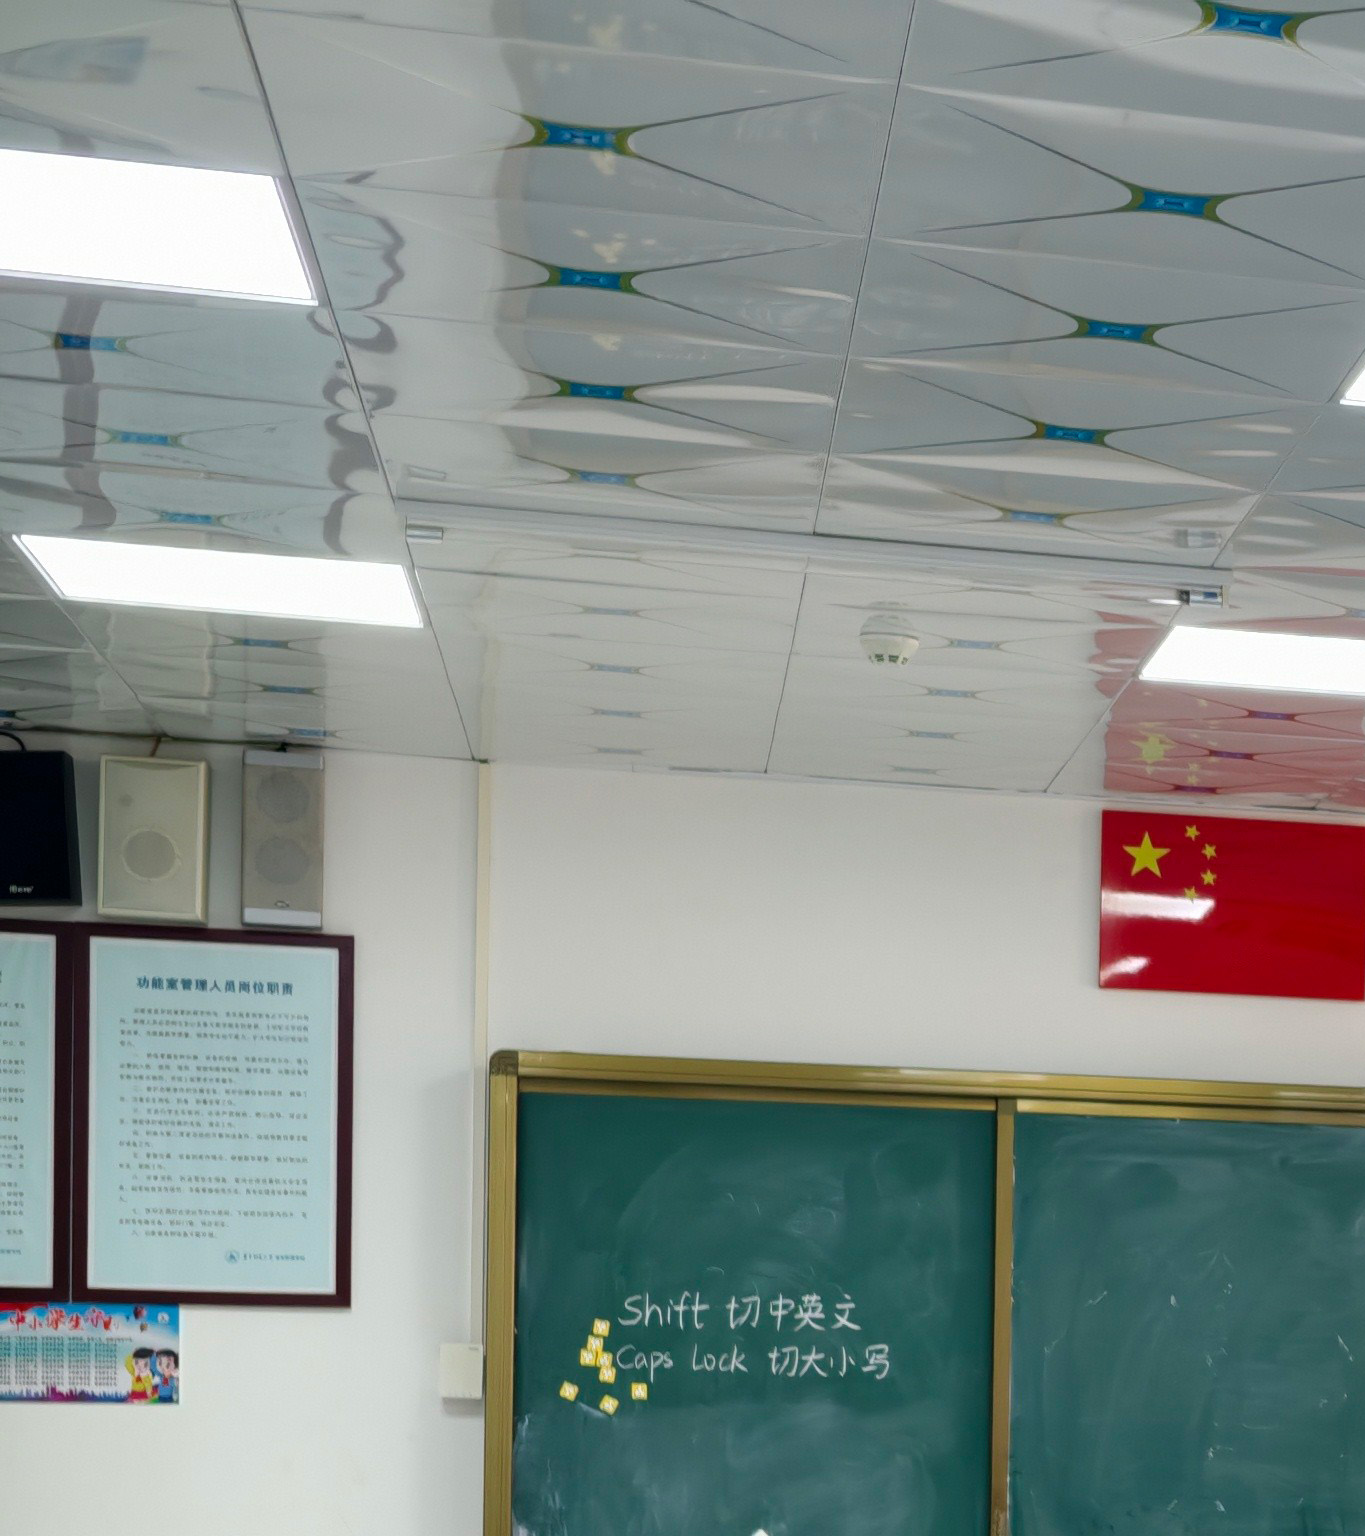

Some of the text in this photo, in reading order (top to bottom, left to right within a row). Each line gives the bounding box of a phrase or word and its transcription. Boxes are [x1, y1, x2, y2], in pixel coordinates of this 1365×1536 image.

[618, 1291, 861, 1332] Shift 切中英文
[616, 1344, 674, 1383] Caps
[769, 1343, 890, 1380] 切大小写
